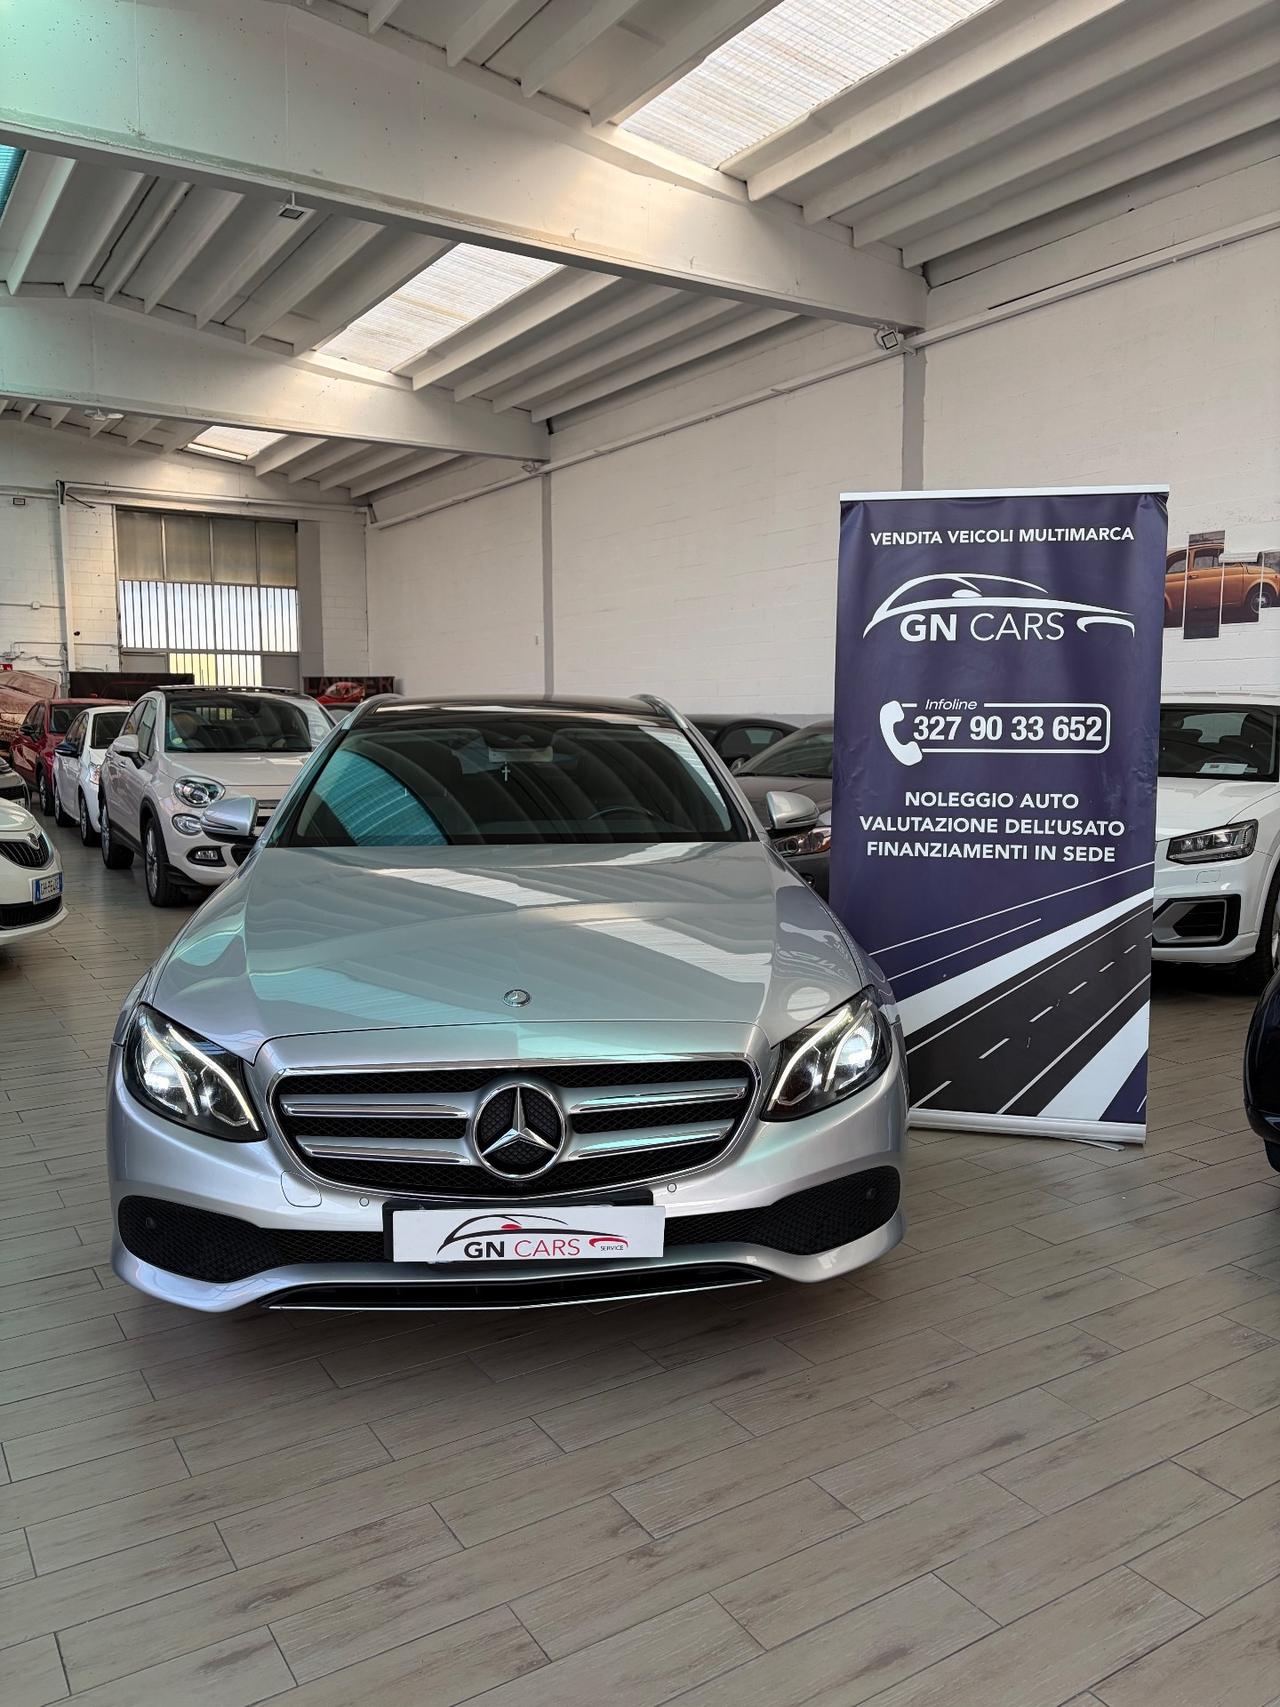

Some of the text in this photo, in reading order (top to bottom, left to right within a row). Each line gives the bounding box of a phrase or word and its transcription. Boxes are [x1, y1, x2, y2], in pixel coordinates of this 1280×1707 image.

[871, 526, 1134, 546] VENDITA VEICOLI MULTIMARCA
[900, 612, 1064, 642] GN CARS
[925, 699, 978, 711] Infoline
[913, 716, 1101, 741] 327 90 33 652
[906, 792, 1078, 809] NOLEGGIO AUTO
[860, 816, 1124, 836] VALUTAZIONE DELL'USATO
[868, 842, 1115, 862] FINANZIAMENTI IN SEDE
[464, 1240, 504, 1258] GN
[515, 1238, 580, 1257] CARS
